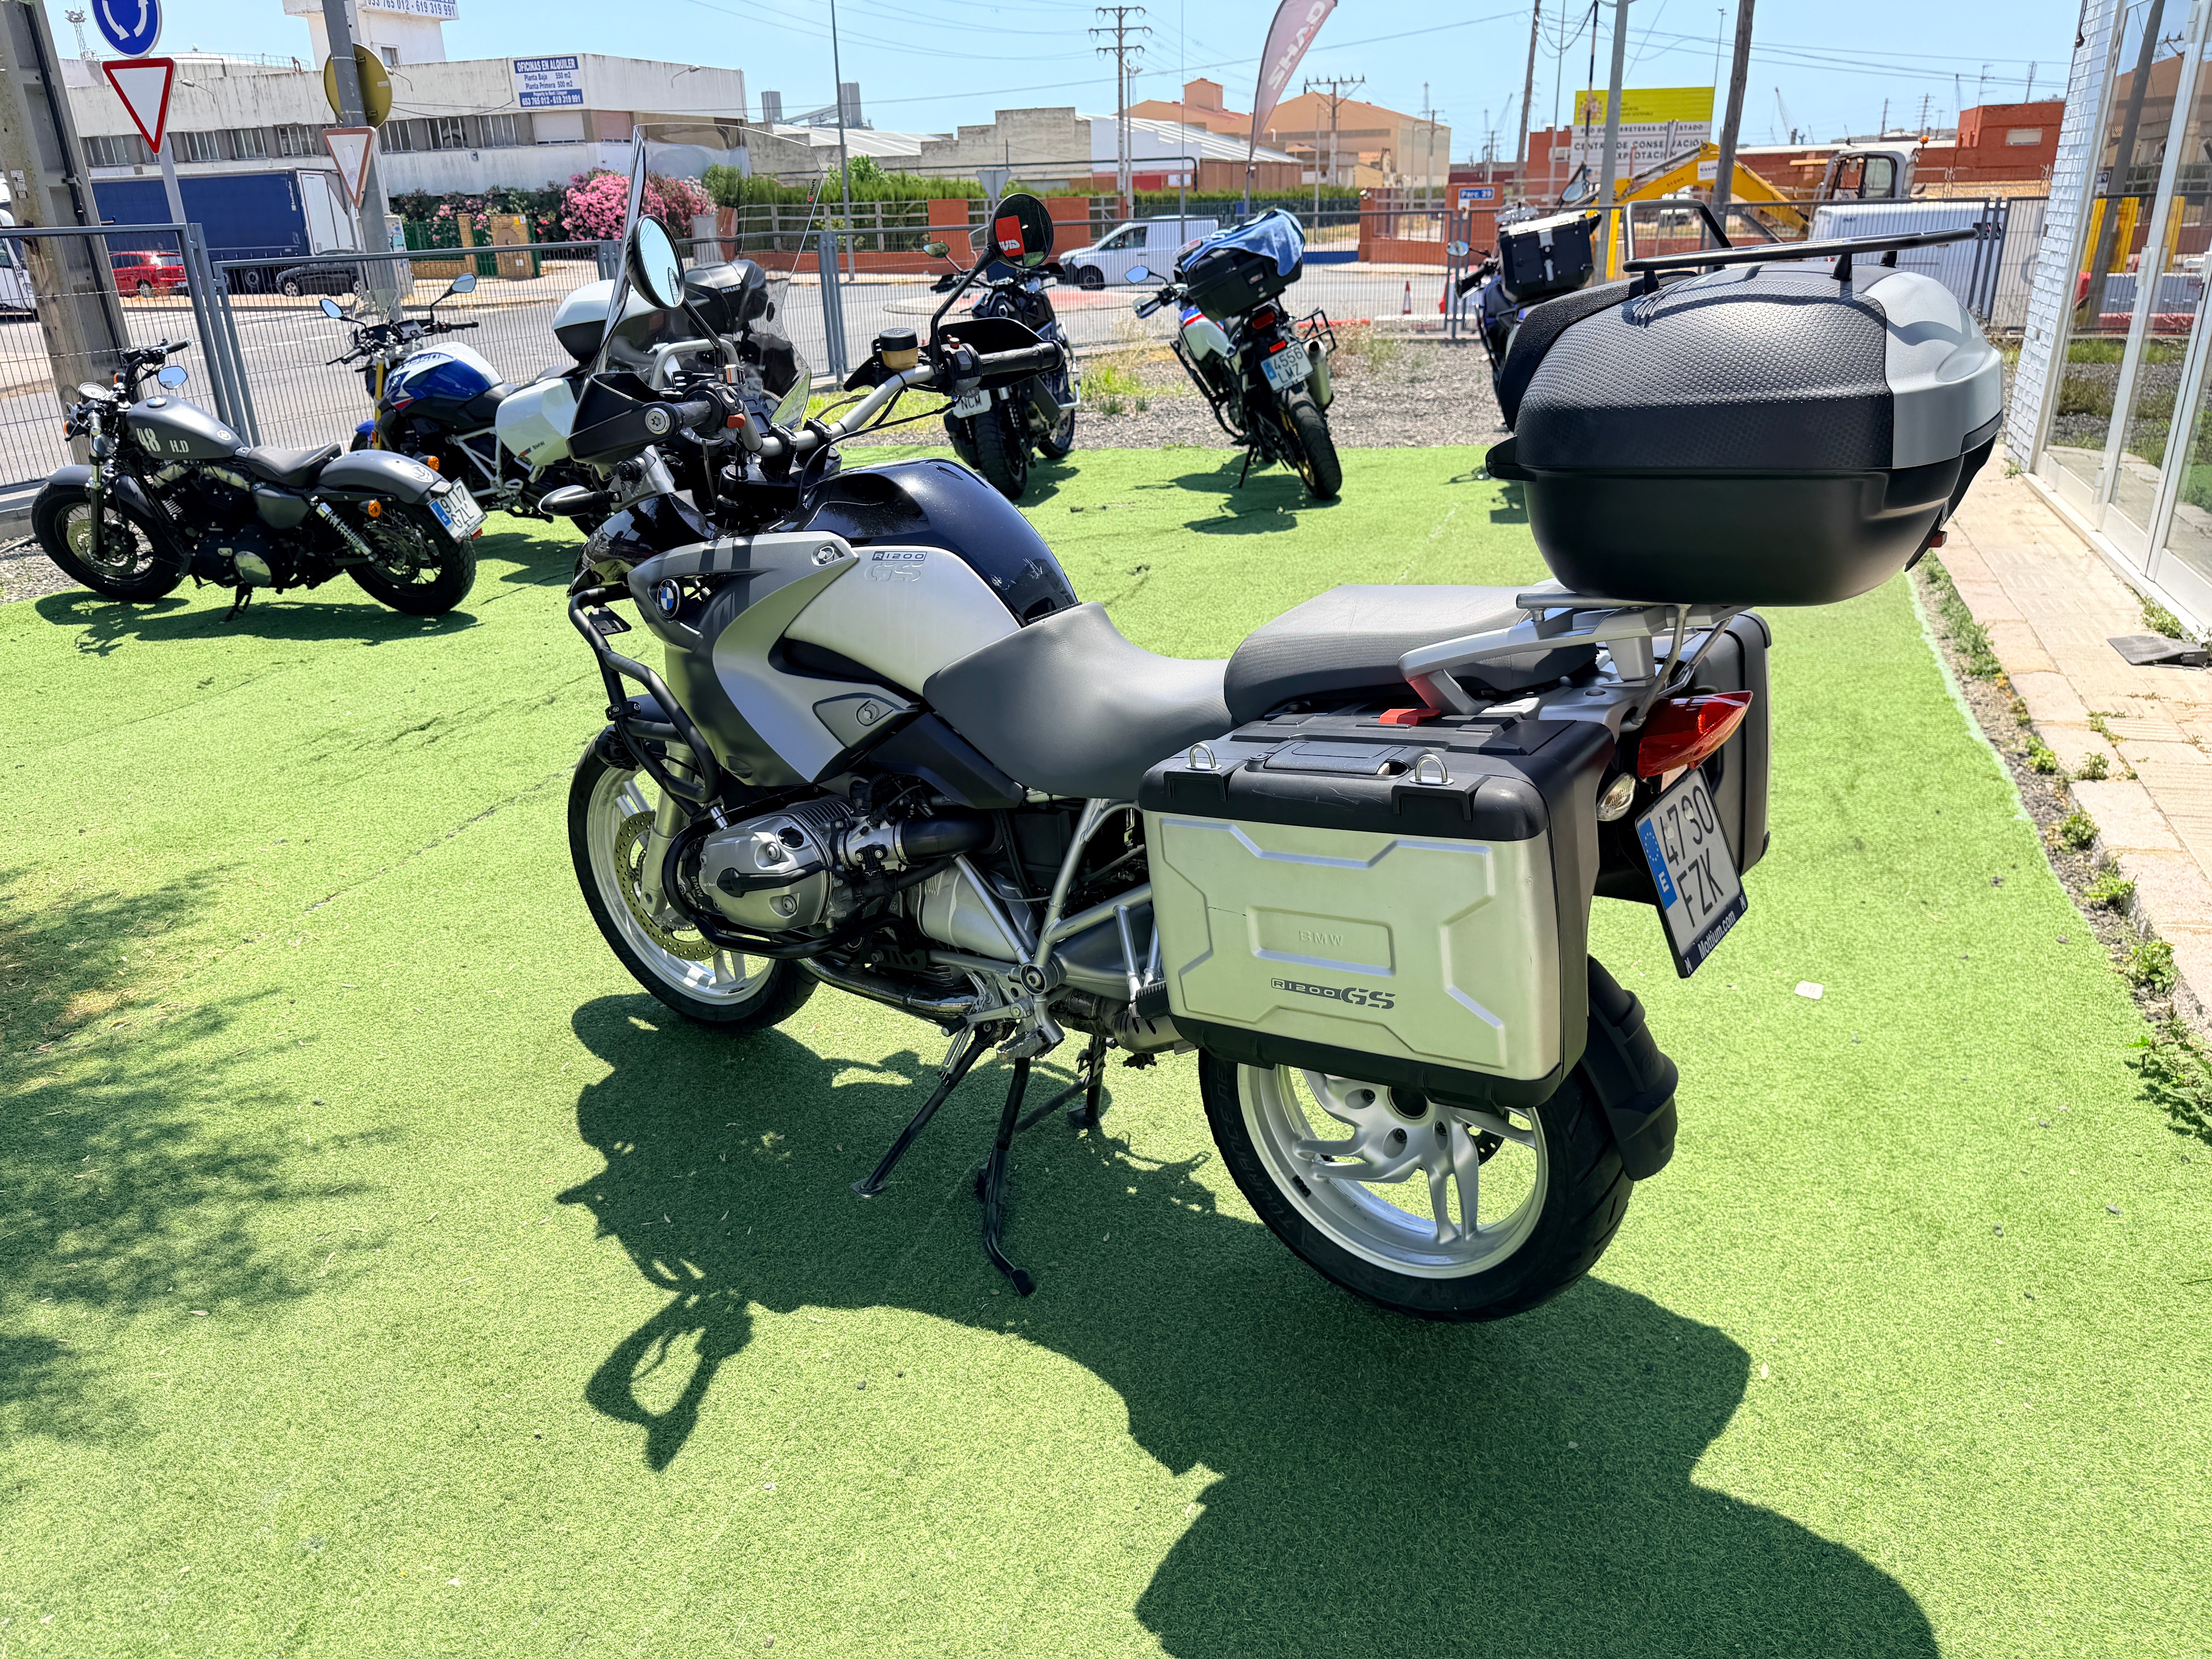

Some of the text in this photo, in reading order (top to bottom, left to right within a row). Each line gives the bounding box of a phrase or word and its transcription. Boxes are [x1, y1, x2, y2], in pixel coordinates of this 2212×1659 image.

[397, 0, 409, 10] 012
[416, 1, 428, 12] 619
[430, 2, 441, 14] 319
[444, 4, 455, 16] 991
[1267, 1, 1326, 91] SHAD
[517, 58, 576, 72] OFICINAS EN ALQUILER
[538, 73, 547, 82] Baja
[522, 94, 580, 106] 653 765 012 619 319 991
[721, 284, 741, 294] SHAD
[1273, 347, 1303, 370] 4556
[1277, 363, 1302, 383] LMZ
[961, 395, 982, 410] NCM
[136, 428, 189, 453] 48 H.D
[440, 485, 468, 514] 9117
[450, 507, 474, 528] GZL
[864, 562, 924, 581] GS
[1659, 785, 1714, 866] 4730
[691, 876, 704, 897] BMW
[1658, 871, 1669, 893] E
[1676, 847, 1724, 928] FZK
[1298, 930, 1344, 946] BMW
[1685, 895, 1746, 975] M Mottium.com M
